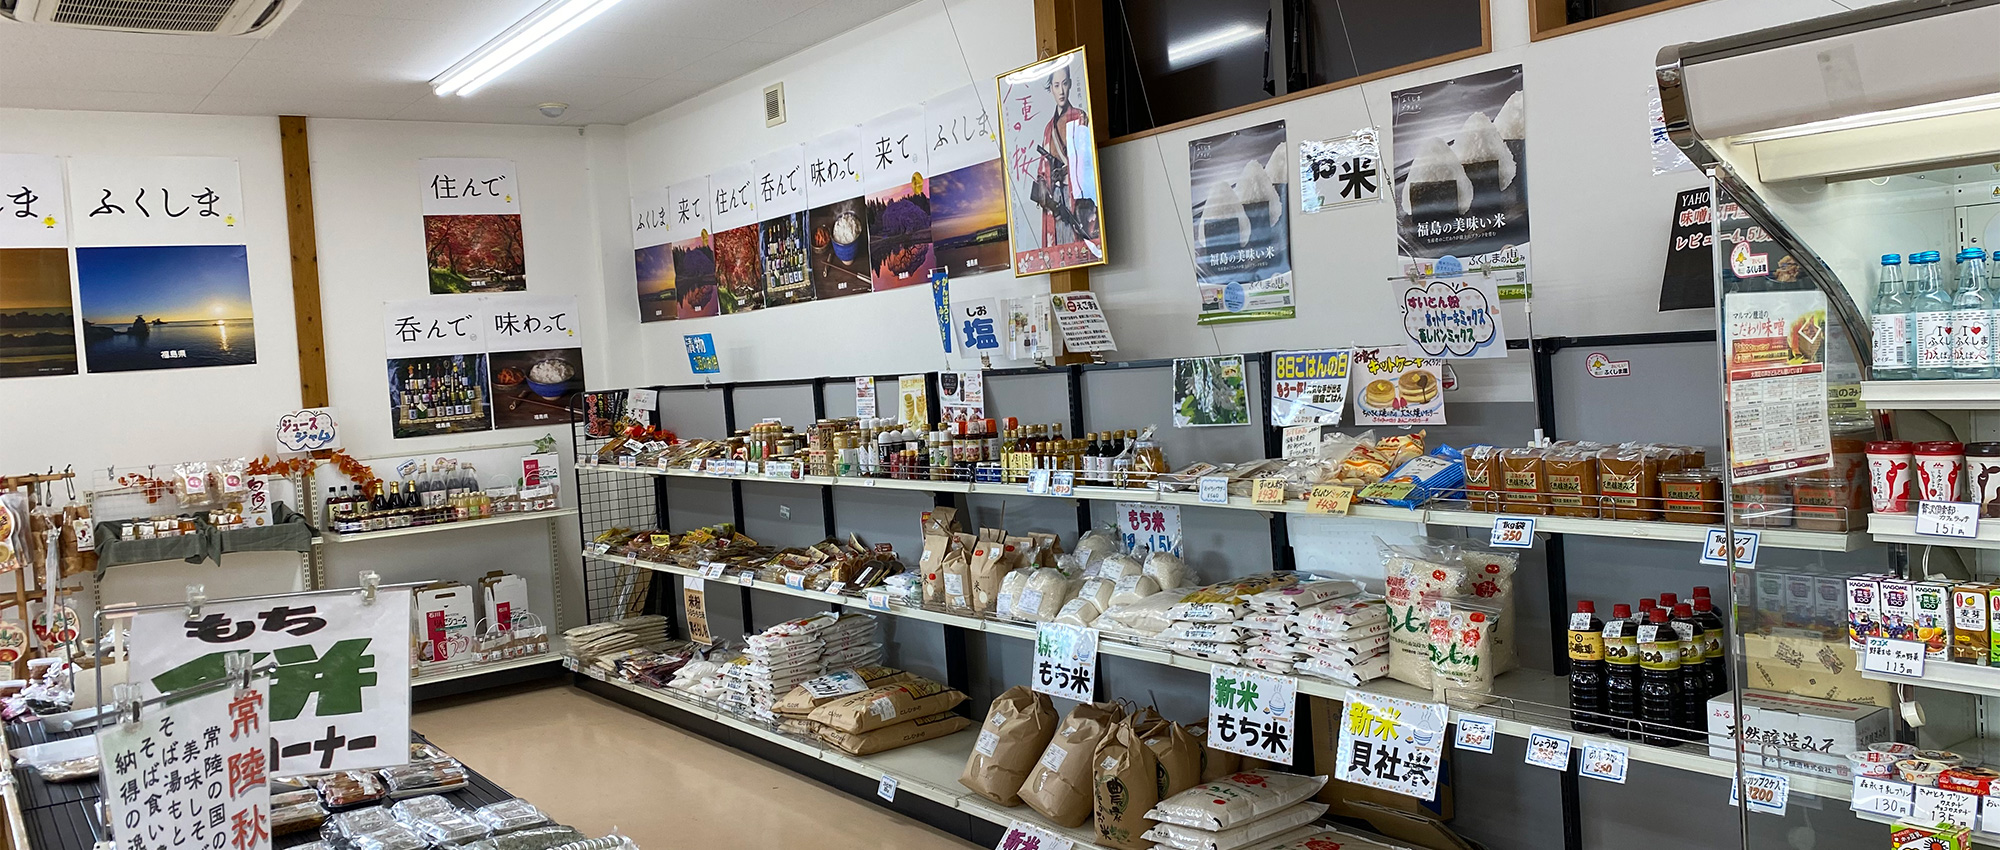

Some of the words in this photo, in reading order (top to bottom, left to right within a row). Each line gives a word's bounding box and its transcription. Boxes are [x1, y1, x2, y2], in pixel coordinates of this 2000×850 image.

[934, 113, 990, 151] ふくしま
[875, 133, 911, 170] 来て
[810, 152, 855, 188] 味わって
[1307, 152, 1378, 200] お米
[430, 174, 505, 200] 住んで
[760, 165, 800, 203] 呑んで
[0, 186, 39, 218] ま
[89, 186, 220, 218] ふくしま
[678, 196, 701, 225] 来て
[715, 180, 752, 217] 住んで
[1682, 190, 1724, 207] YAHO!
[636, 206, 667, 232] ふくしま
[1417, 212, 1506, 237] 福島の美味い米
[1210, 245, 1275, 267] 福島の美味い米
[1469, 247, 1525, 266] ふくしまの恵み
[966, 305, 987, 317] しお
[1407, 295, 1460, 309] すいとん粉
[394, 314, 474, 343] 呑んで
[494, 312, 566, 337] 味わって
[963, 318, 999, 349] 塩
[1732, 317, 1786, 337] こだわり味噌
[1962, 325, 1969, 337] I
[1955, 335, 1989, 346] ふくしま
[1276, 354, 1348, 379] 8日ごはんの日
[281, 416, 319, 432] ジュース
[294, 428, 331, 444] ジャム
[1257, 488, 1278, 500] ¥430
[1315, 499, 1338, 510] ¥430
[1128, 509, 1166, 533] もち米
[1502, 520, 1527, 531] 1kg袋
[1497, 529, 1523, 542] ¥550
[1709, 545, 1745, 559] ¥60
[1883, 583, 1908, 591] KAGOME
[184, 605, 328, 643] もち
[1038, 661, 1091, 694] もち米
[1214, 676, 1259, 713] 新米
[1348, 701, 1402, 742] 新米
[1713, 708, 1751, 722] ふるの
[1217, 713, 1288, 755] もち米
[1532, 736, 1559, 750] しょうゆ
[1725, 725, 1835, 754] 天然醸造みそ
[183, 738, 211, 850] 美味しそ
[203, 725, 227, 850] 常陸の国の
[1946, 793, 1969, 803] プリン
[1003, 828, 1041, 850] 新米
